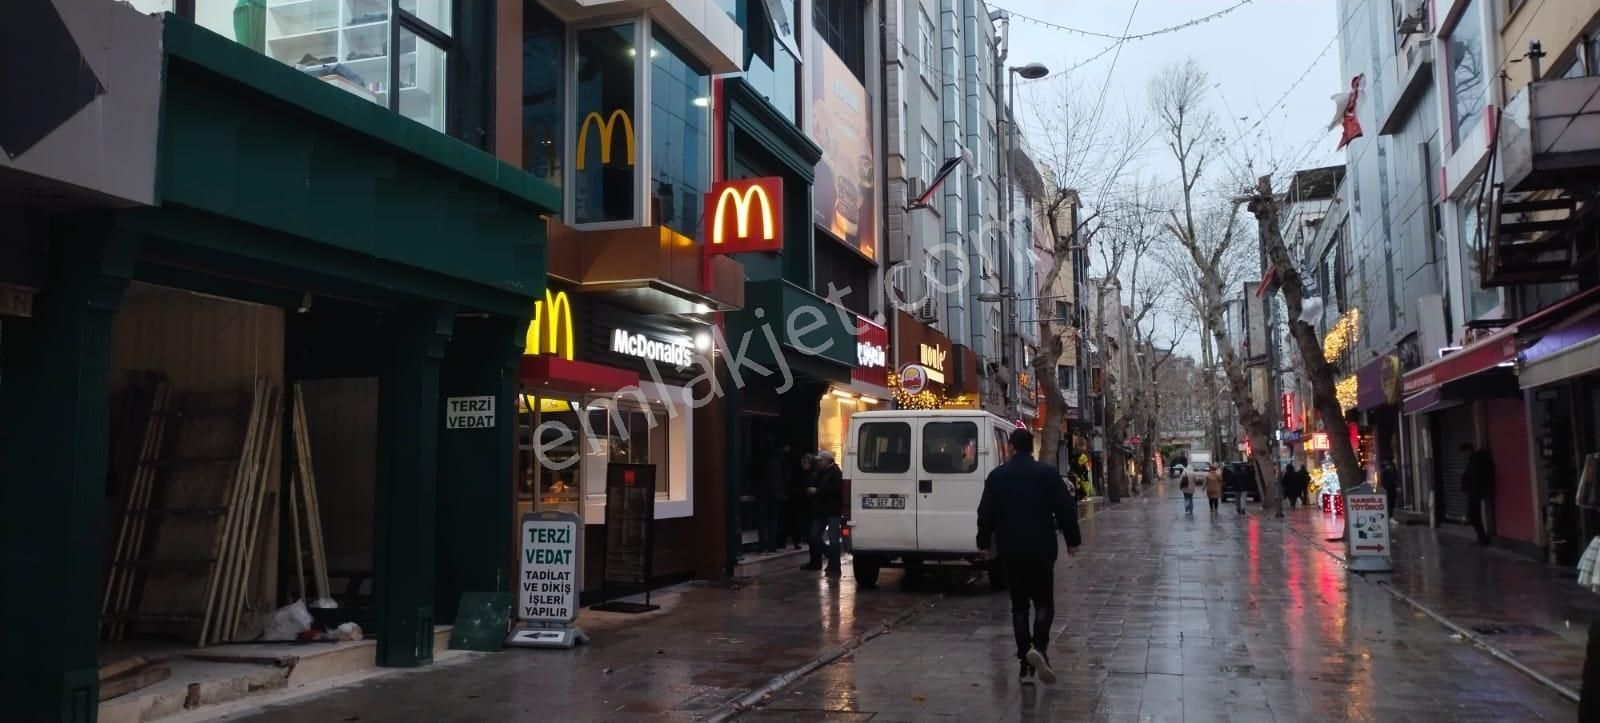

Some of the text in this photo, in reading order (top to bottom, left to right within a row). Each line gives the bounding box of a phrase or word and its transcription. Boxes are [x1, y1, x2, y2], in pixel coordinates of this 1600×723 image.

[614, 328, 692, 367] McDonald's
[451, 397, 492, 412] TERZİ
[448, 415, 494, 428] VEDAT
[528, 525, 571, 544] TERZİ
[526, 549, 572, 565] VEDAT
[525, 568, 571, 581] TADİLAT
[523, 580, 571, 595] VE DİKİŞ
[529, 593, 565, 607] İŞLERİ
[524, 606, 568, 618] YAPILIR
